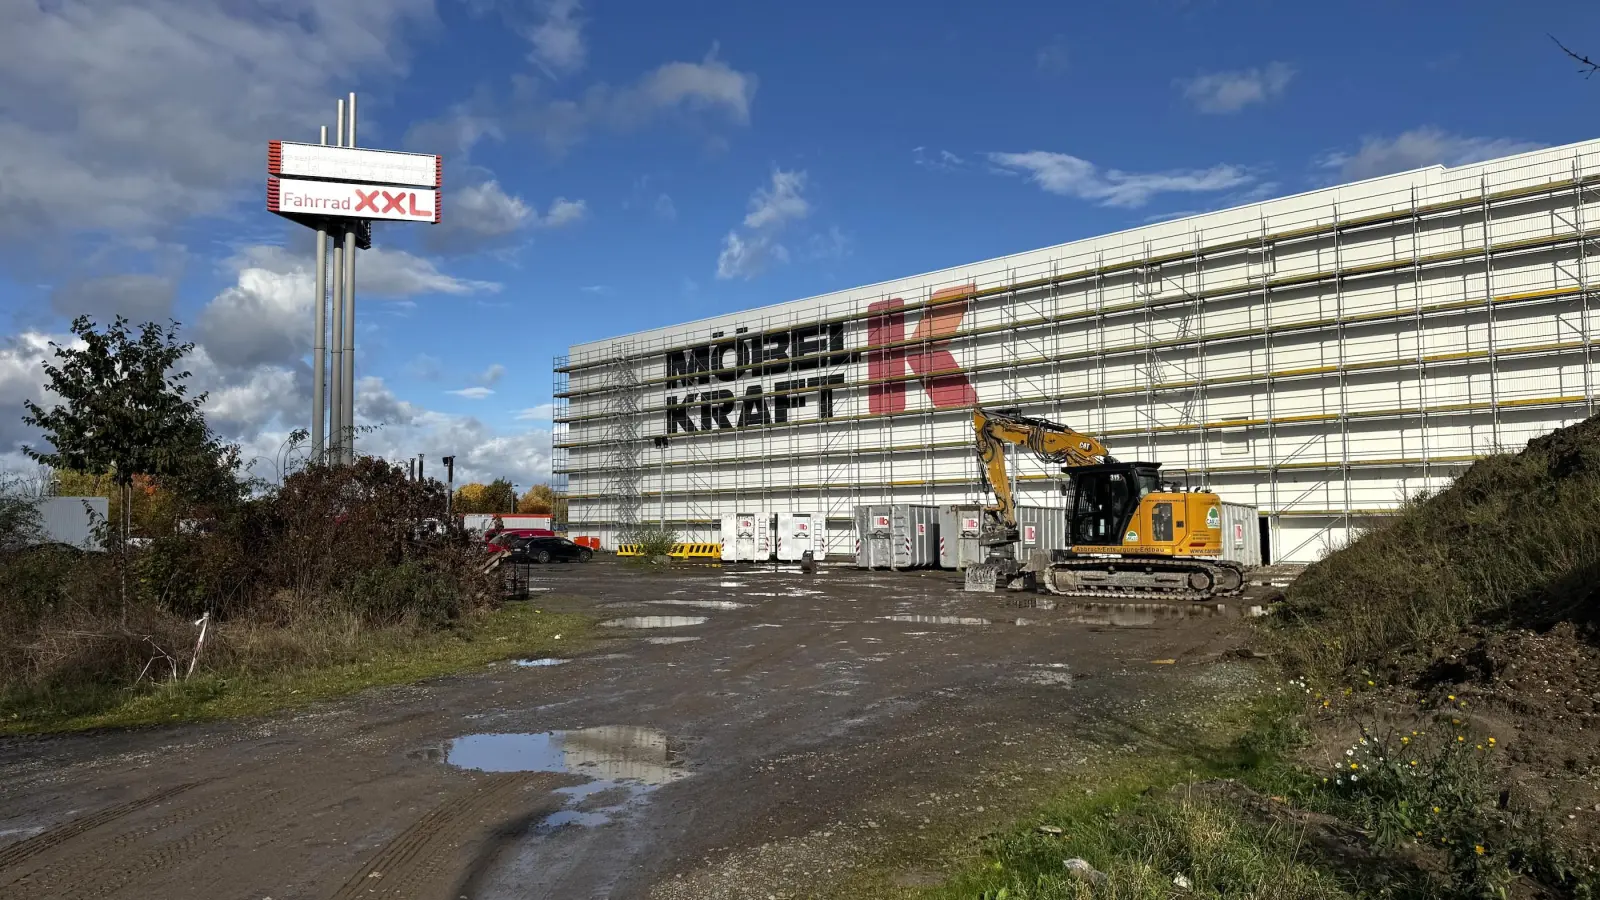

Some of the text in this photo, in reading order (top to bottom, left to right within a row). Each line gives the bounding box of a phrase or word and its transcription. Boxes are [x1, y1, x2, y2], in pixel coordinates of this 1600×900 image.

[283, 188, 433, 217] Fahrrad XXL
[666, 322, 862, 390] MÖBEL
[666, 373, 845, 434] KRAFT
[1079, 442, 1091, 451] CAT
